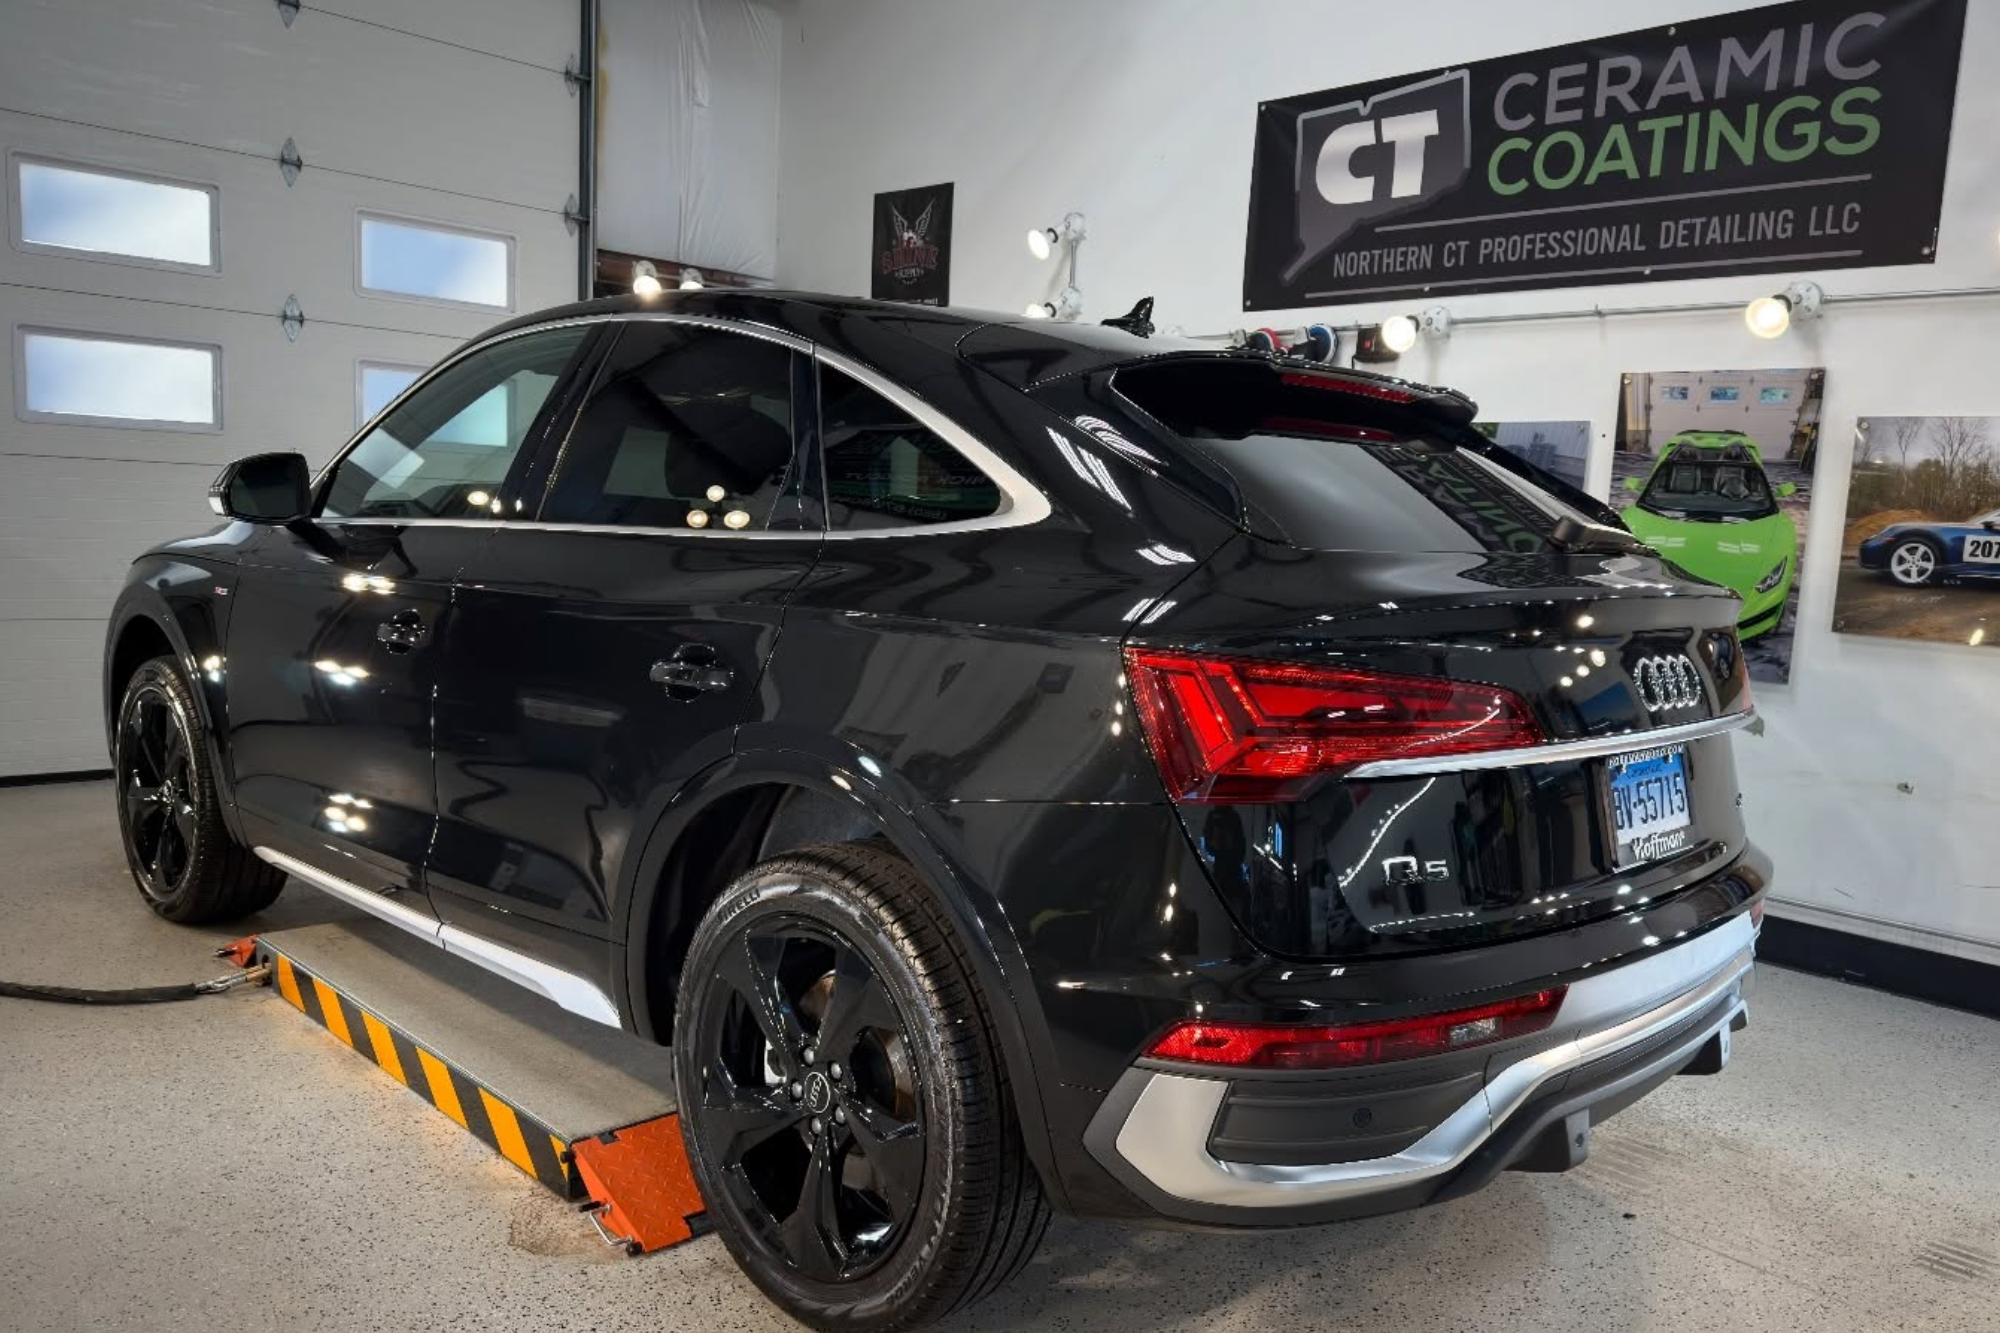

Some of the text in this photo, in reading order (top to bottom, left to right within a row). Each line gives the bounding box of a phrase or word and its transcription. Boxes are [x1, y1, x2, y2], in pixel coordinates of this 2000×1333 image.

[1493, 12, 1886, 131] CERAMIC
[1315, 109, 1440, 205] CT
[1487, 86, 1883, 196] COATINGS
[1333, 202, 1861, 278] NORTHERN CT PROFESSIONAL DETAILING LLC
[1969, 540, 2000, 559] 207
[1381, 855, 1449, 886] Q5
